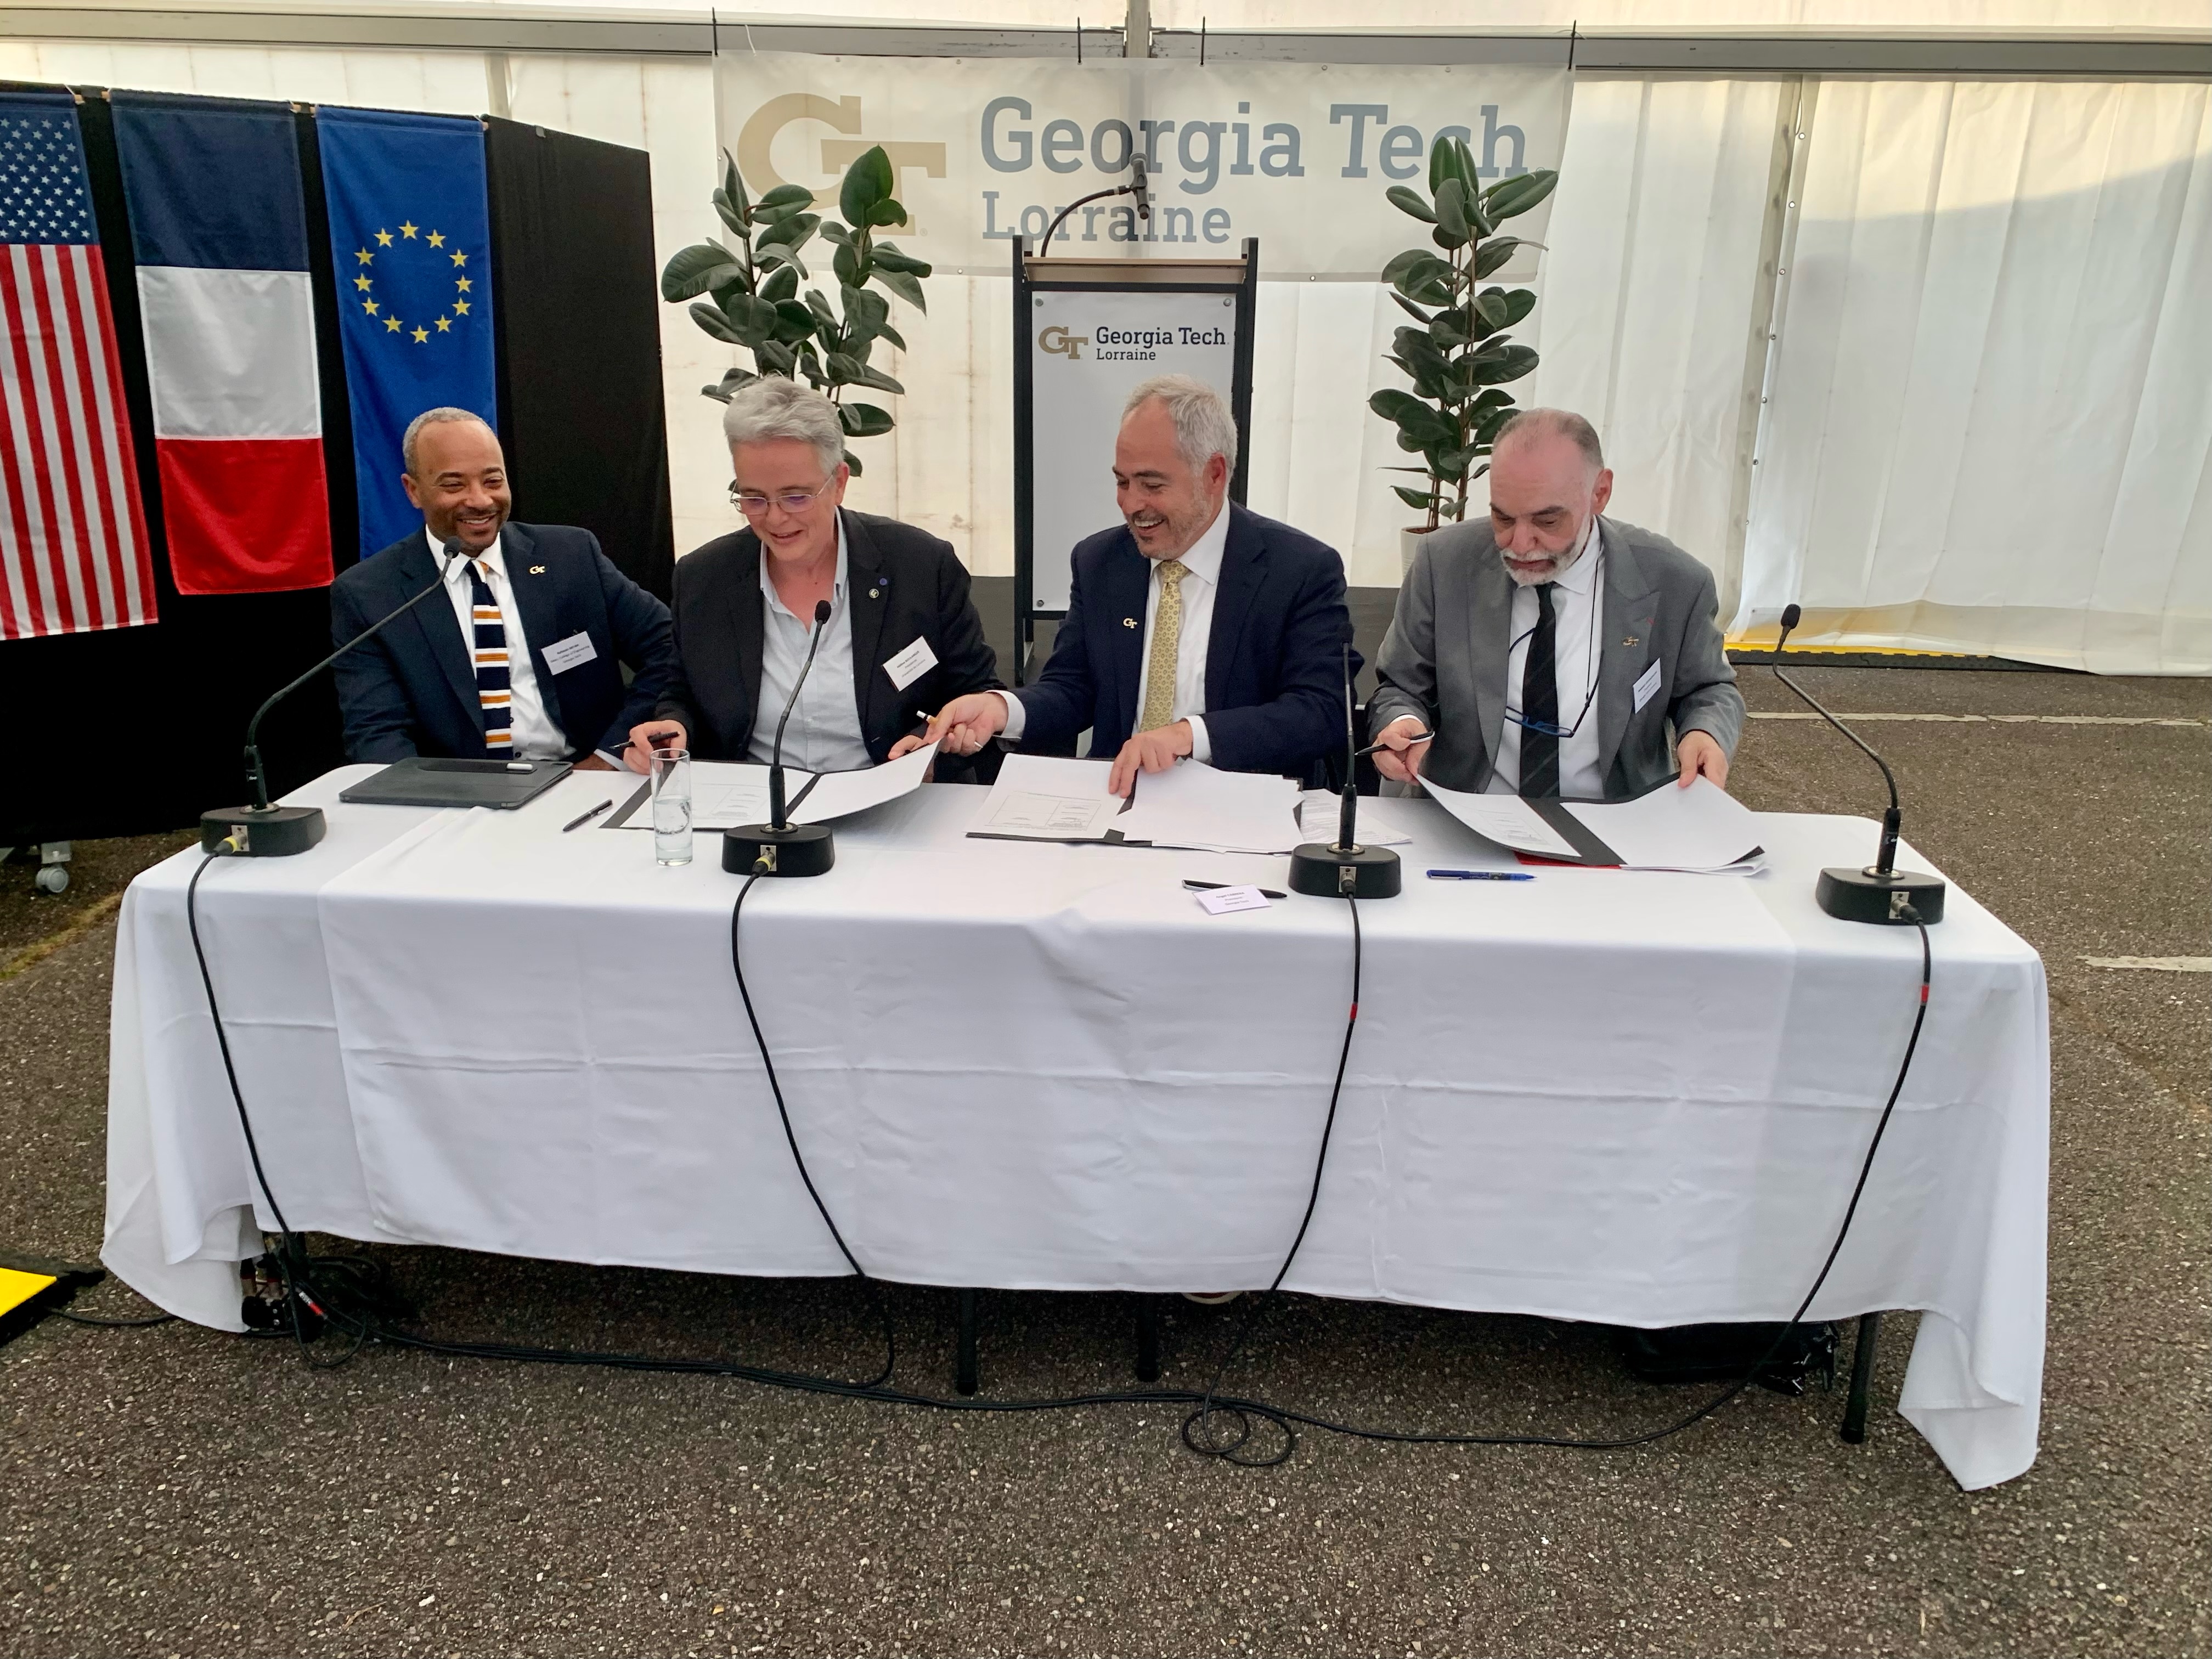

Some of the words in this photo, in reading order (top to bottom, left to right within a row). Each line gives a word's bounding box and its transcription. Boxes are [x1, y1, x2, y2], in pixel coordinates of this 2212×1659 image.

[981, 96, 1305, 193] Georgia
[982, 191, 1231, 243] Lorraine
[1039, 326, 1088, 359] GT
[1096, 326, 1173, 348] Georgia
[1178, 328, 1226, 345] Tech
[1096, 348, 1156, 360] Lorraine
[1123, 618, 1137, 629] GT
